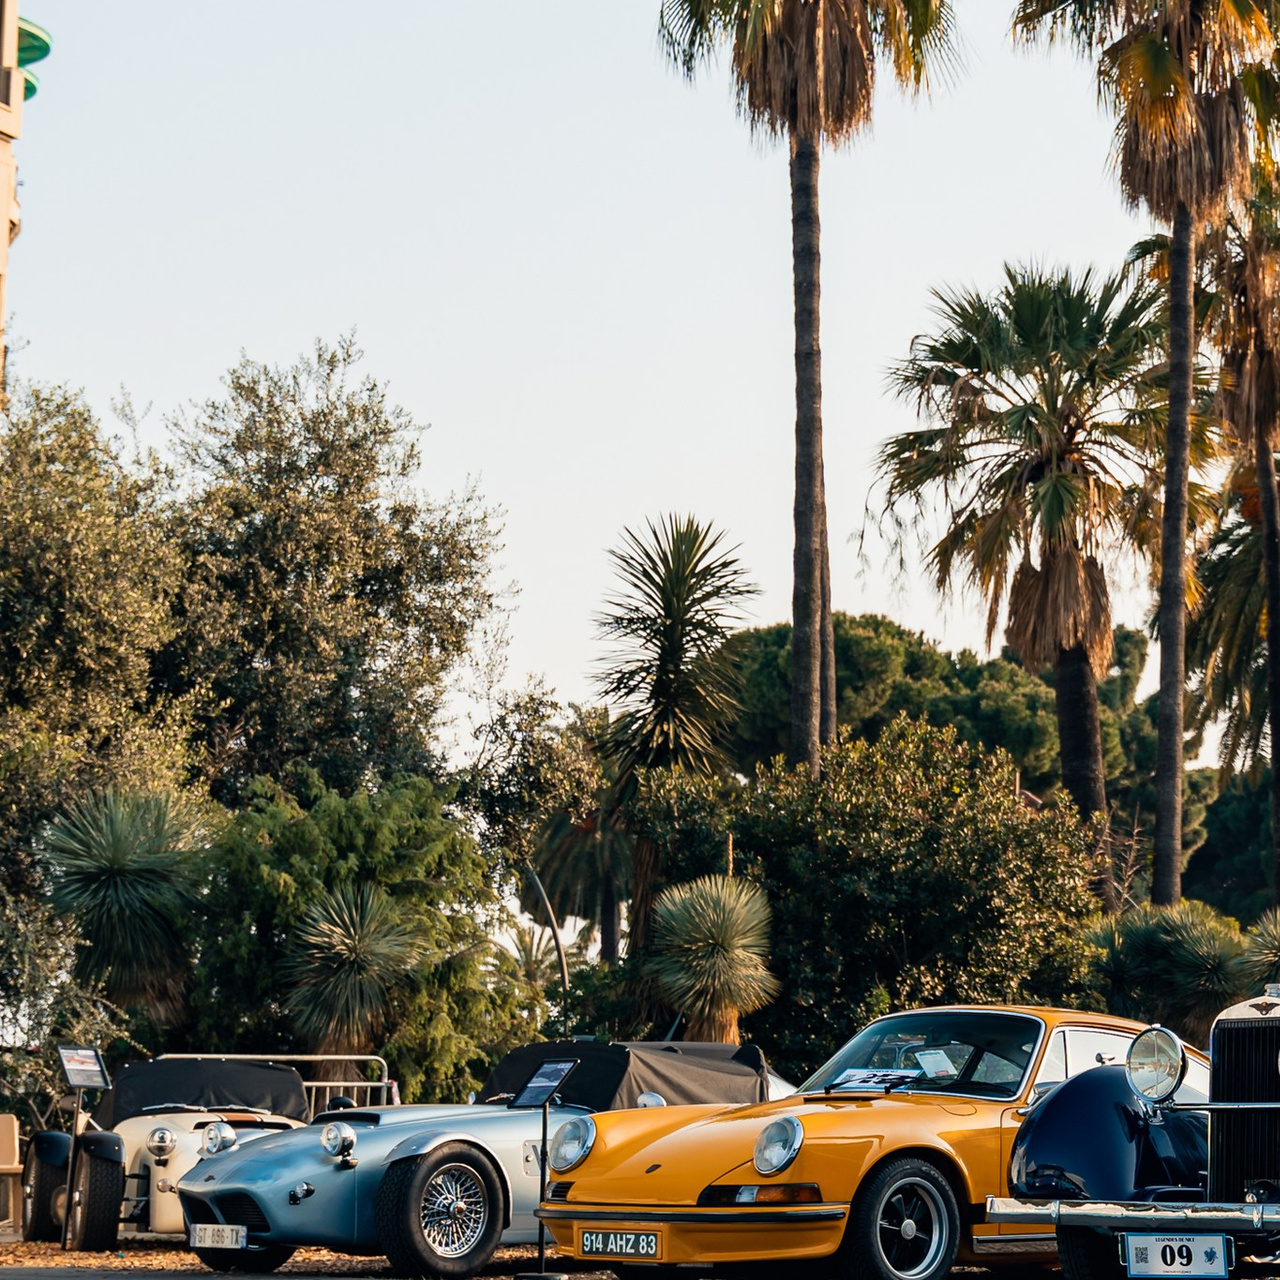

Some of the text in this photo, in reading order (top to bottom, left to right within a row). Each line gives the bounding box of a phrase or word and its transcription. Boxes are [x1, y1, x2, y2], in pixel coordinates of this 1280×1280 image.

[583, 1232, 656, 1254] 914 AHZ 83
[1161, 1244, 1193, 1267] 09
